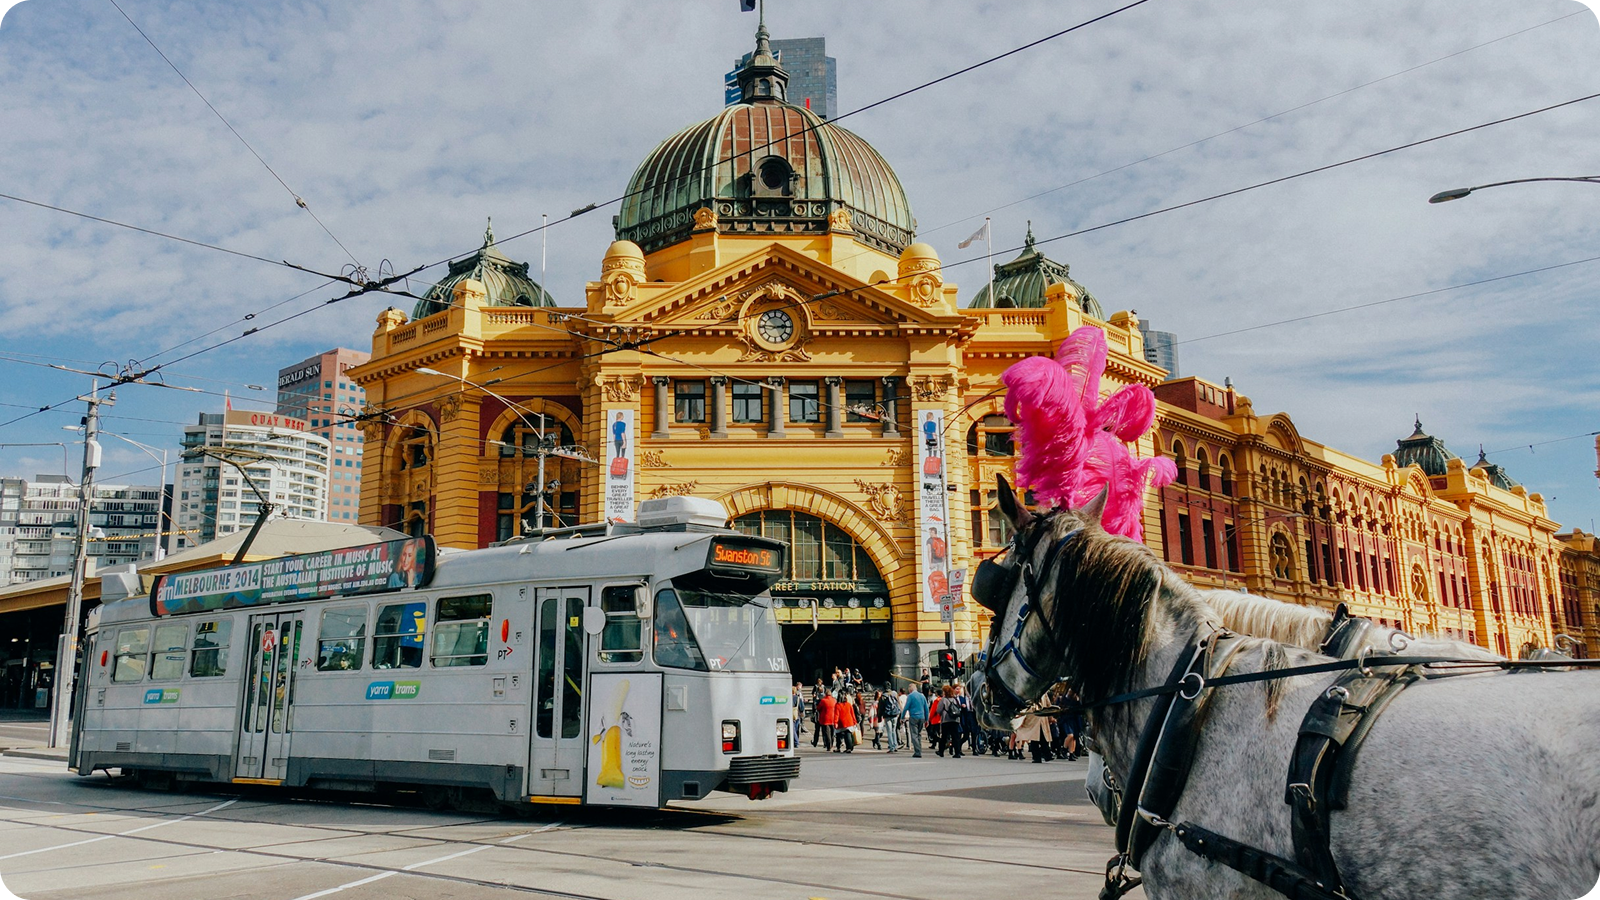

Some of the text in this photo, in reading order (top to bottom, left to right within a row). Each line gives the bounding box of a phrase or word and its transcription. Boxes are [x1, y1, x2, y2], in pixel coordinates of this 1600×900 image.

[306, 364, 320, 378] SUN
[251, 414, 304, 431] QUAY WEST
[264, 548, 382, 575] START YOUR CAREER IN MUSIC AT
[715, 544, 771, 566] Swanston St
[262, 560, 393, 588] THE AUSTRALIAN INSTITUTE OF MUSIC
[175, 573, 231, 596] MELBOURNE
[234, 569, 259, 588] 2014
[811, 582, 856, 591] STATION
[498, 650, 507, 660] PT
[301, 660, 308, 669] PT
[709, 658, 721, 669] PT
[768, 658, 784, 671] 167
[370, 683, 417, 696] yarra trams
[146, 692, 178, 702] yarra trams
[637, 750, 655, 758] lasting
